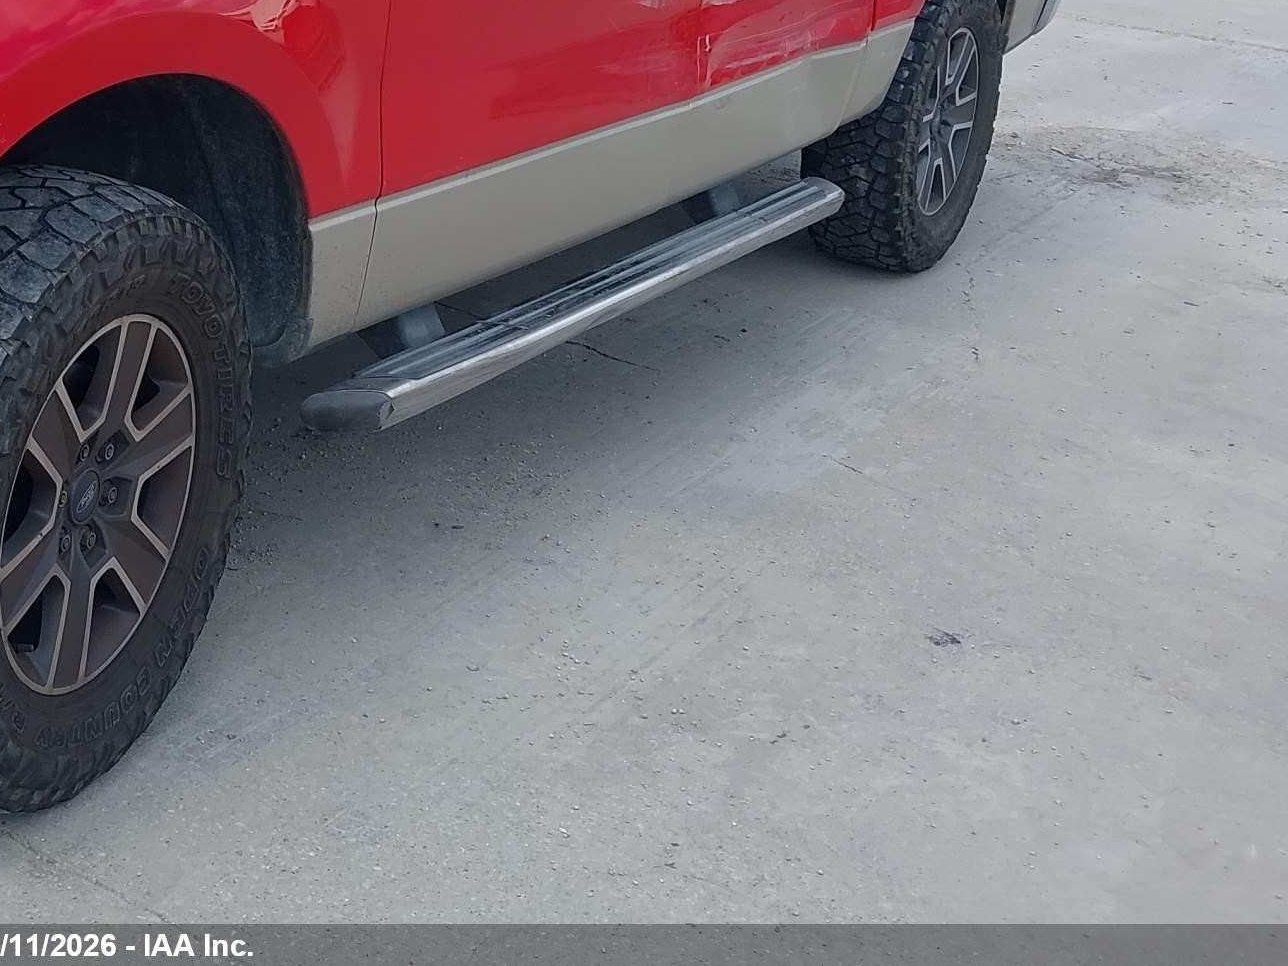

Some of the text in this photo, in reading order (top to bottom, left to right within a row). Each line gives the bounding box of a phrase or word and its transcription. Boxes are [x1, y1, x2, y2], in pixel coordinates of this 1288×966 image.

[169, 272, 237, 480] TOYO TIRES
[154, 545, 210, 667] OPEN
[33, 665, 152, 748] COUNTRY
